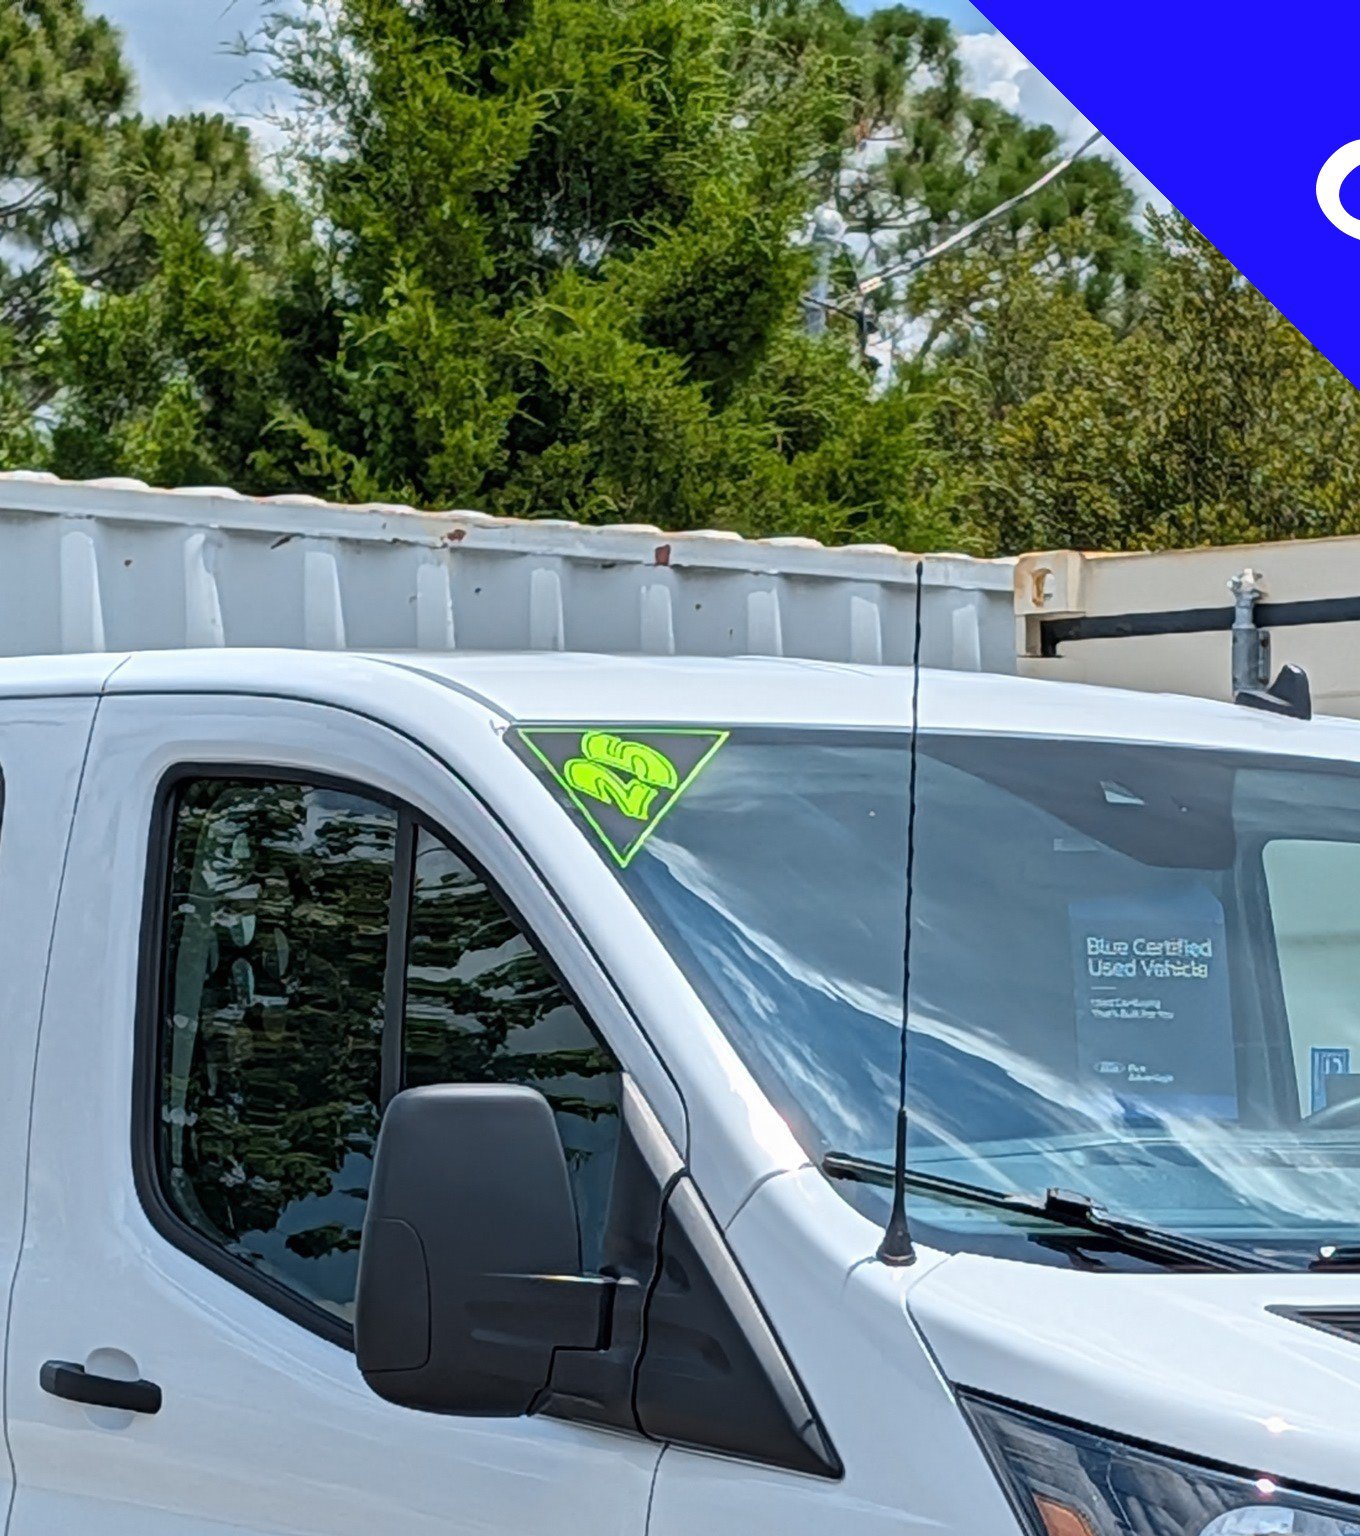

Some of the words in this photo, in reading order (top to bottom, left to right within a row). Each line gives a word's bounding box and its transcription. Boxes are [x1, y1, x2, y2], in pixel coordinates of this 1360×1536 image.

[564, 731, 677, 820] 25
[1087, 937, 1128, 955] Blue
[1133, 938, 1212, 957] Certified
[1088, 958, 1136, 977] Used
[1141, 960, 1208, 978] Vehicle
